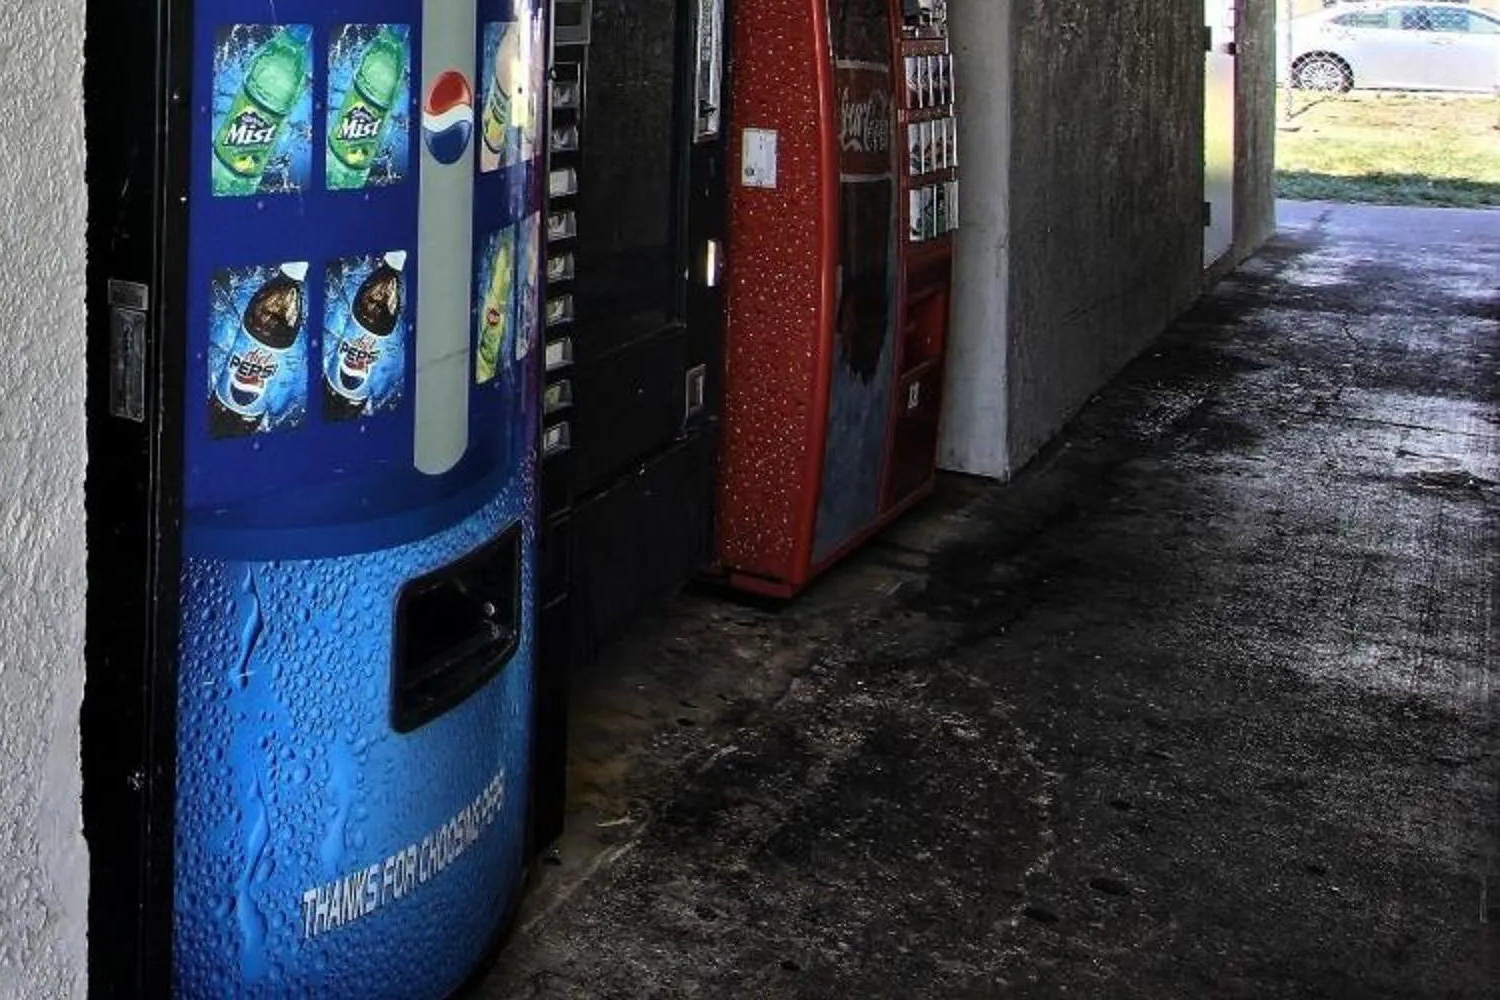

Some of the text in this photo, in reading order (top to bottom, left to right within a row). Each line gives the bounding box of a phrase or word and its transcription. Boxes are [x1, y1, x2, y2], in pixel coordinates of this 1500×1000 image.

[223, 122, 277, 146] Mist
[338, 117, 382, 141] Mist
[301, 863, 380, 939] THANKS
[381, 844, 417, 904] FOR
